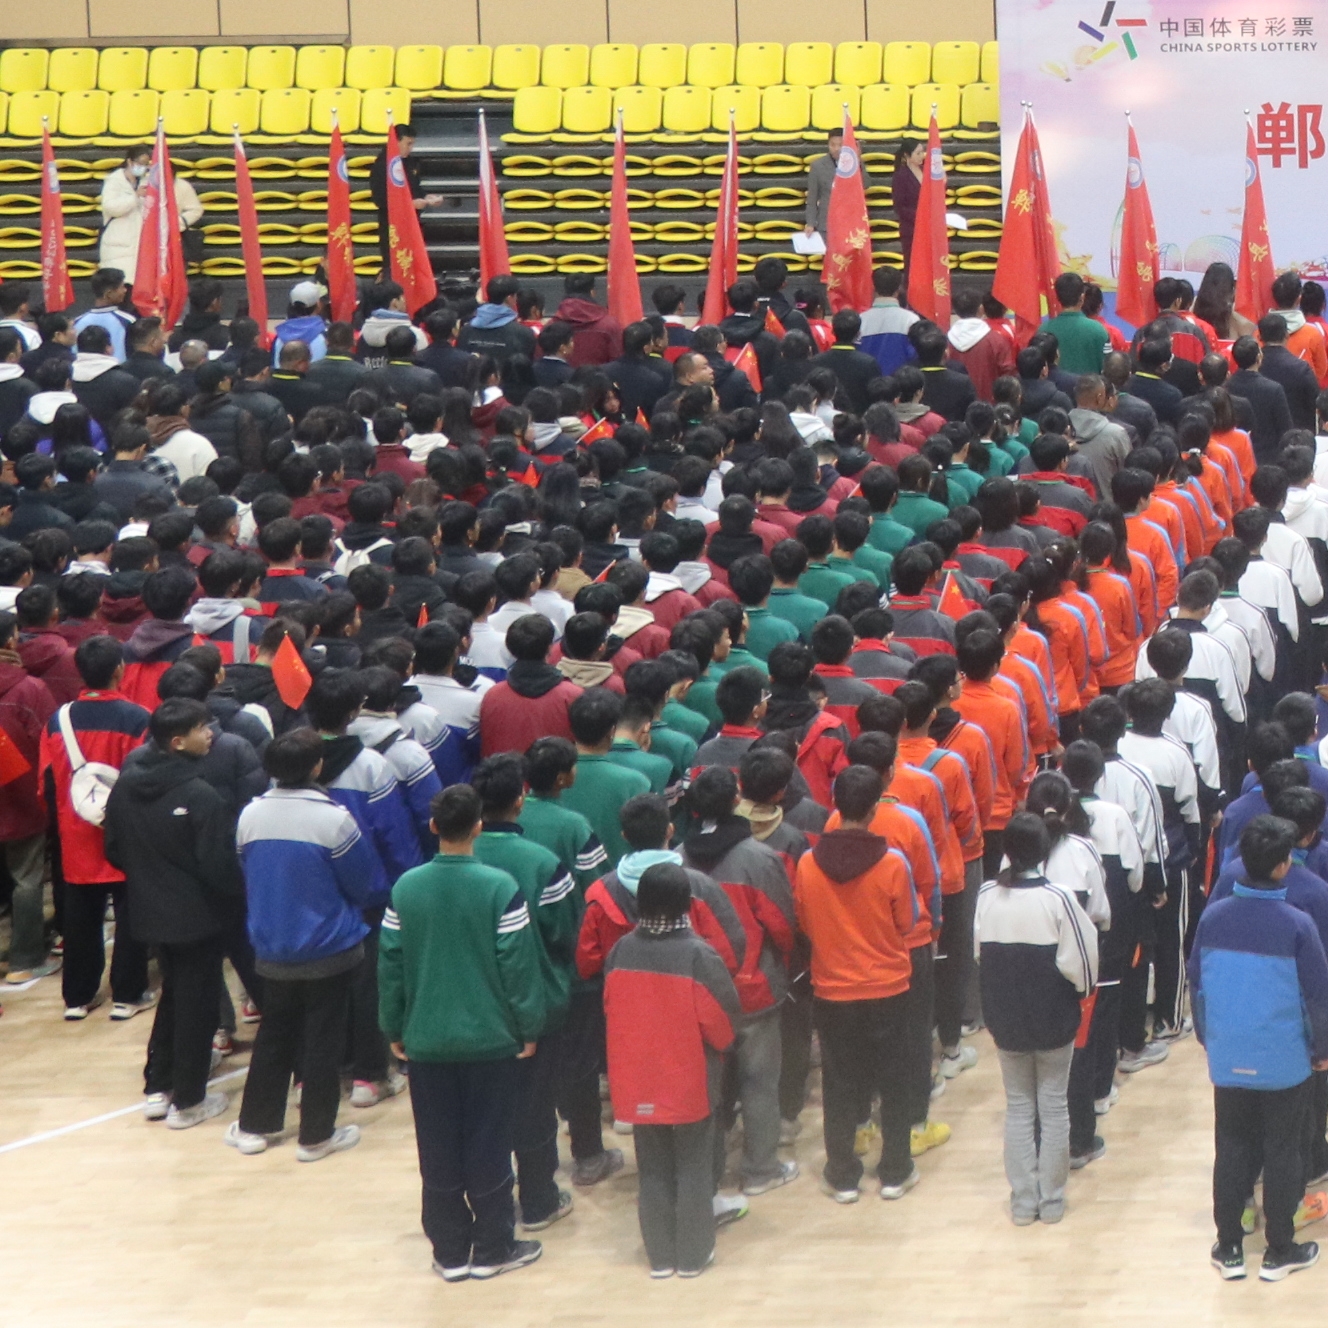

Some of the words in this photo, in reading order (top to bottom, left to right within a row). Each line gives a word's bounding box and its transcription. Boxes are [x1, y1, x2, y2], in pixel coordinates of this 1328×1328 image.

[1159, 16, 1315, 38] 中国体育彩票
[1160, 43, 1203, 53] CHINA
[1207, 42, 1258, 52] SPORTS
[1261, 41, 1318, 52] LOTTERY
